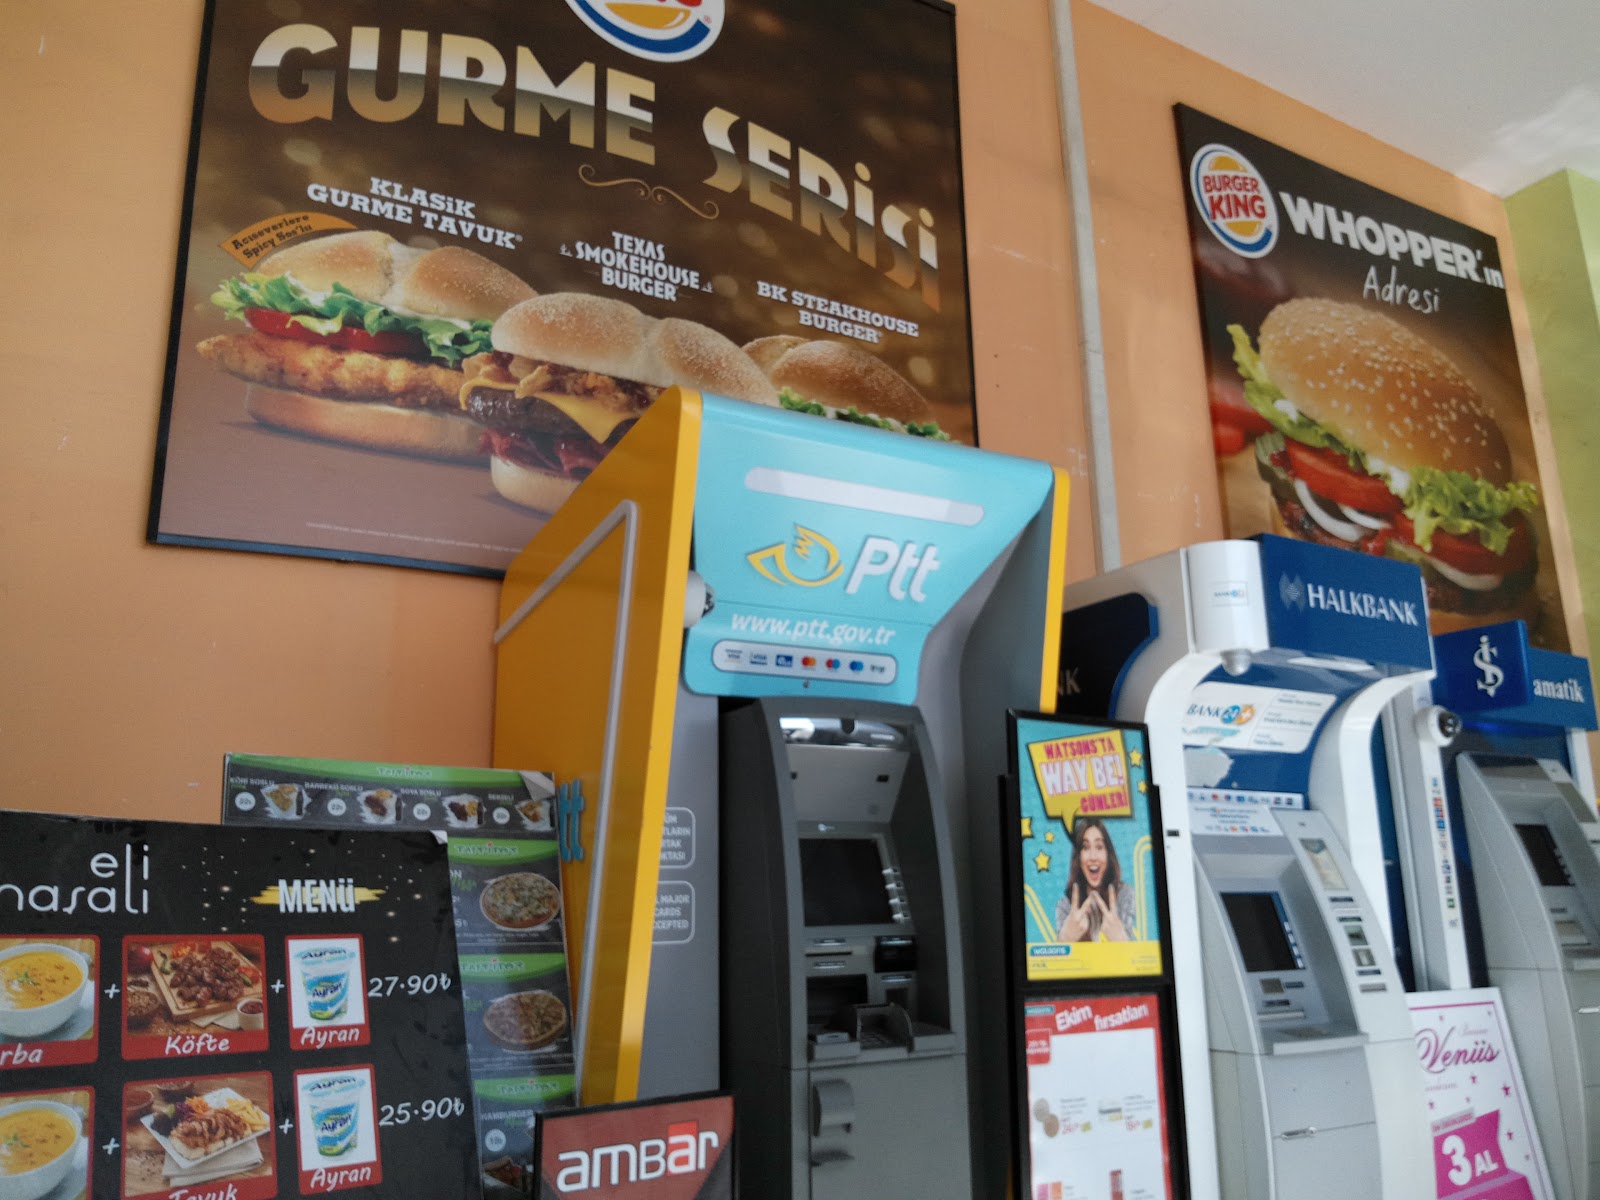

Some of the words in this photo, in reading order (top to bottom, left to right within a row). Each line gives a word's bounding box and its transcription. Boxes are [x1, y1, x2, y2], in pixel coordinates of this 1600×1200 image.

[249, 23, 656, 165] GURME
[1203, 174, 1260, 194] BURGER
[306, 183, 413, 225] GURME
[420, 209, 517, 250] TAVUK
[1208, 193, 1267, 221] KING
[242, 238, 277, 259] Spicy
[611, 230, 665, 262] TEXAS
[575, 240, 700, 290] SMOKEHOUSE
[601, 266, 677, 302] BURGER
[1362, 265, 1440, 314] Adresi
[756, 280, 788, 303] BK
[791, 290, 920, 338] STEAKHOUSE
[798, 309, 879, 344] BURGER
[845, 535, 941, 603] Ptt
[1306, 582, 1419, 626] HALKBANK
[731, 613, 897, 646] www.ptt.gov.tr
[1533, 678, 1585, 703] amatik
[1039, 758, 1089, 795] WAY
[1090, 753, 1125, 789] BE!
[560, 779, 584, 862] tt
[312, 981, 344, 999] Ayran
[1055, 1005, 1094, 1031] Ekim
[0, 1043, 43, 1066] rba
[165, 1033, 230, 1056] Köfte
[300, 1026, 360, 1049] Ayran
[319, 1112, 352, 1133] Ayran
[1442, 1134, 1473, 1186] 3
[1473, 1149, 1500, 1177] AL
[310, 1166, 371, 1192] Ayran
